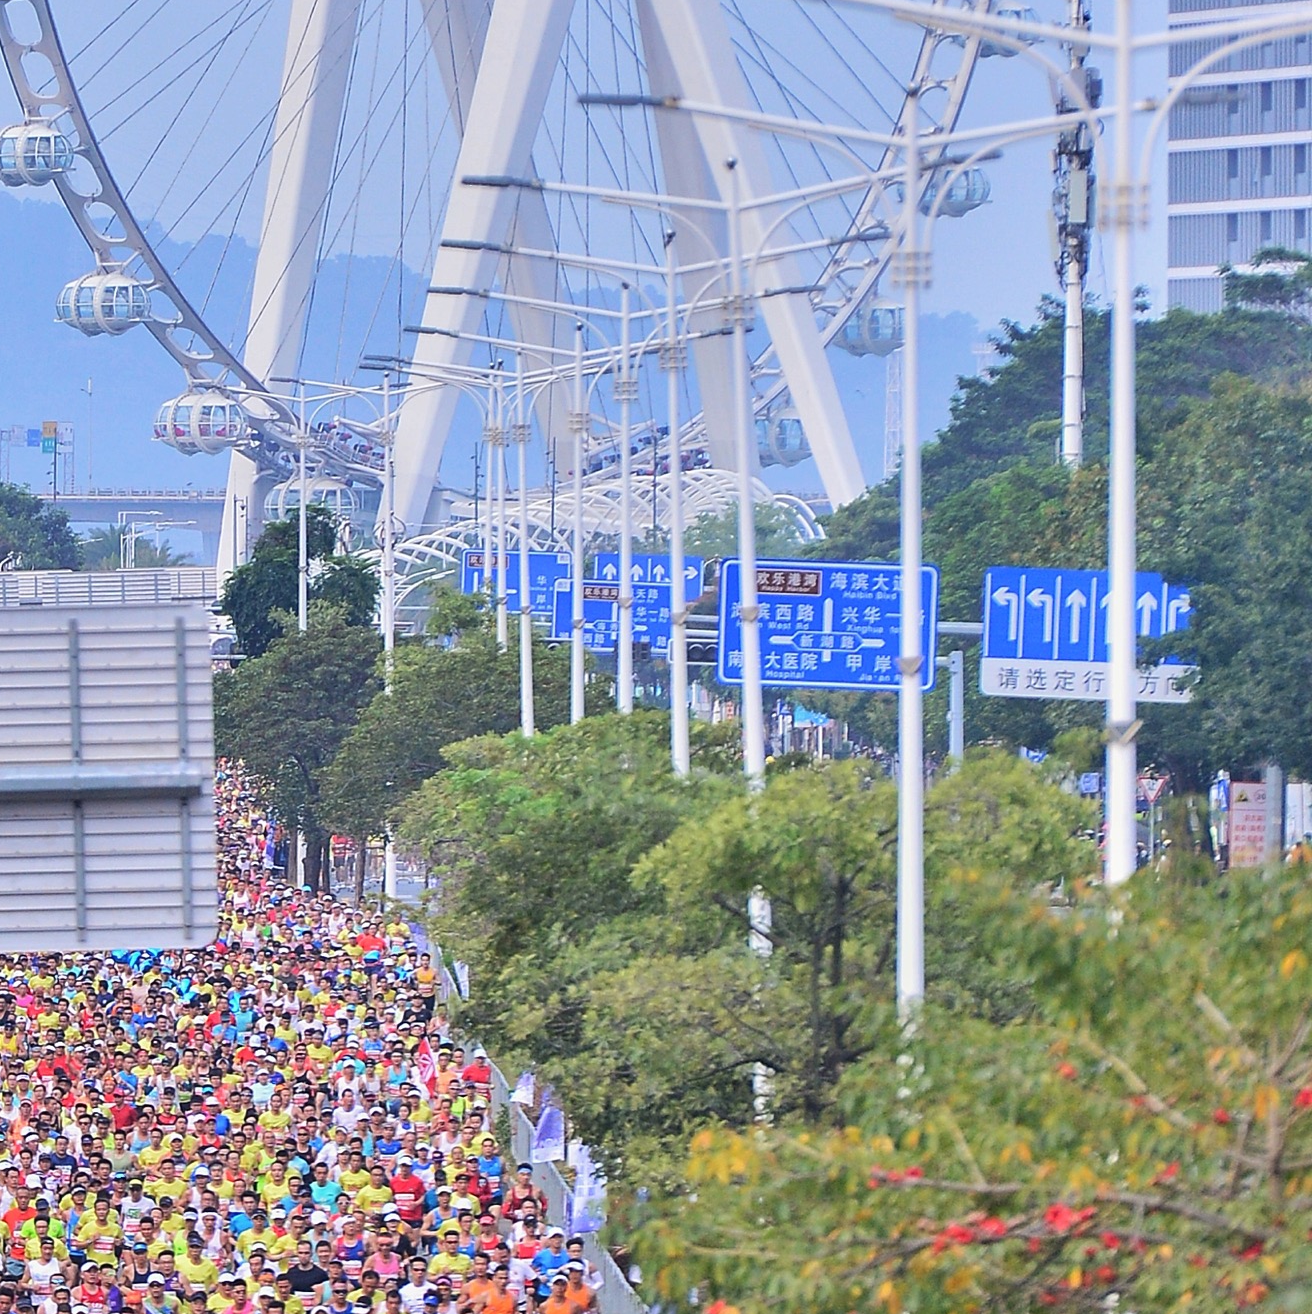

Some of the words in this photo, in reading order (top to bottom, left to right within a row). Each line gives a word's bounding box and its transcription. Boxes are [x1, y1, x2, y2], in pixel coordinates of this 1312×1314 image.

[756, 571, 818, 588] 欢乐港湾
[635, 588, 659, 599] 天路
[635, 606, 670, 619] 华一路
[800, 635, 856, 649] 新湖路
[727, 651, 819, 671] 南大医院
[998, 666, 1185, 696] 请选定行方向
